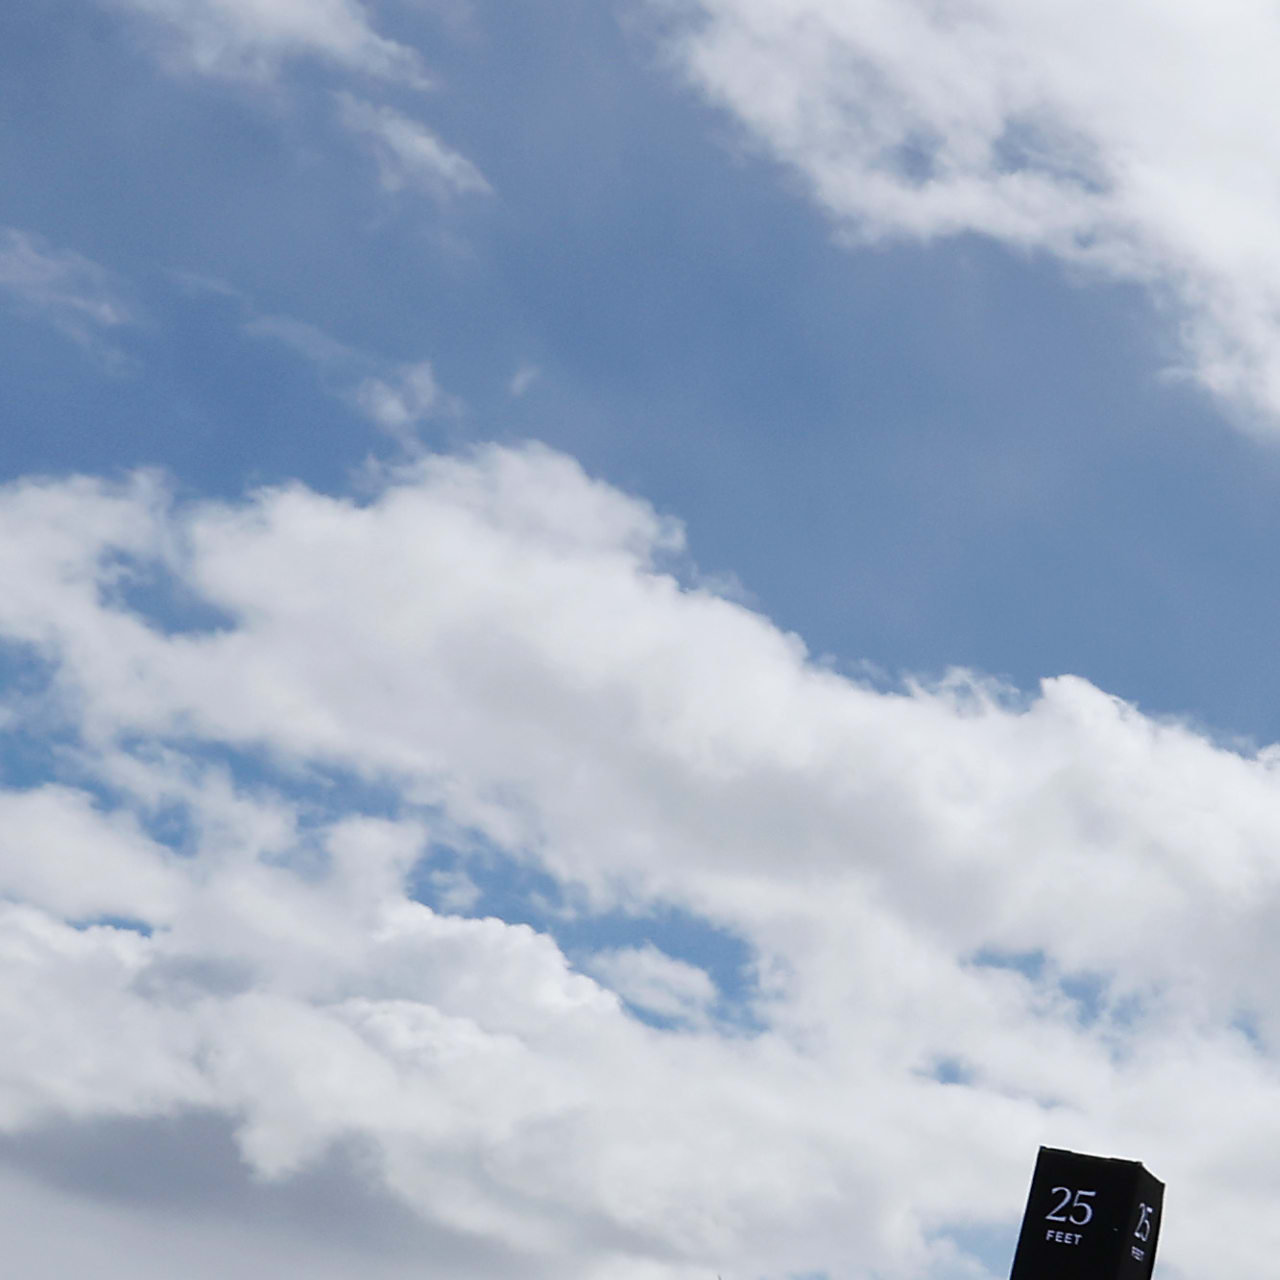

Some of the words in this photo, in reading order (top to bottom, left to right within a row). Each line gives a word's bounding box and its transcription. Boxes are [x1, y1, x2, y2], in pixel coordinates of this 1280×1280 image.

[1045, 1186, 1096, 1225] 25
[1134, 1203, 1153, 1241] 25
[1045, 1229, 1083, 1246] FEET
